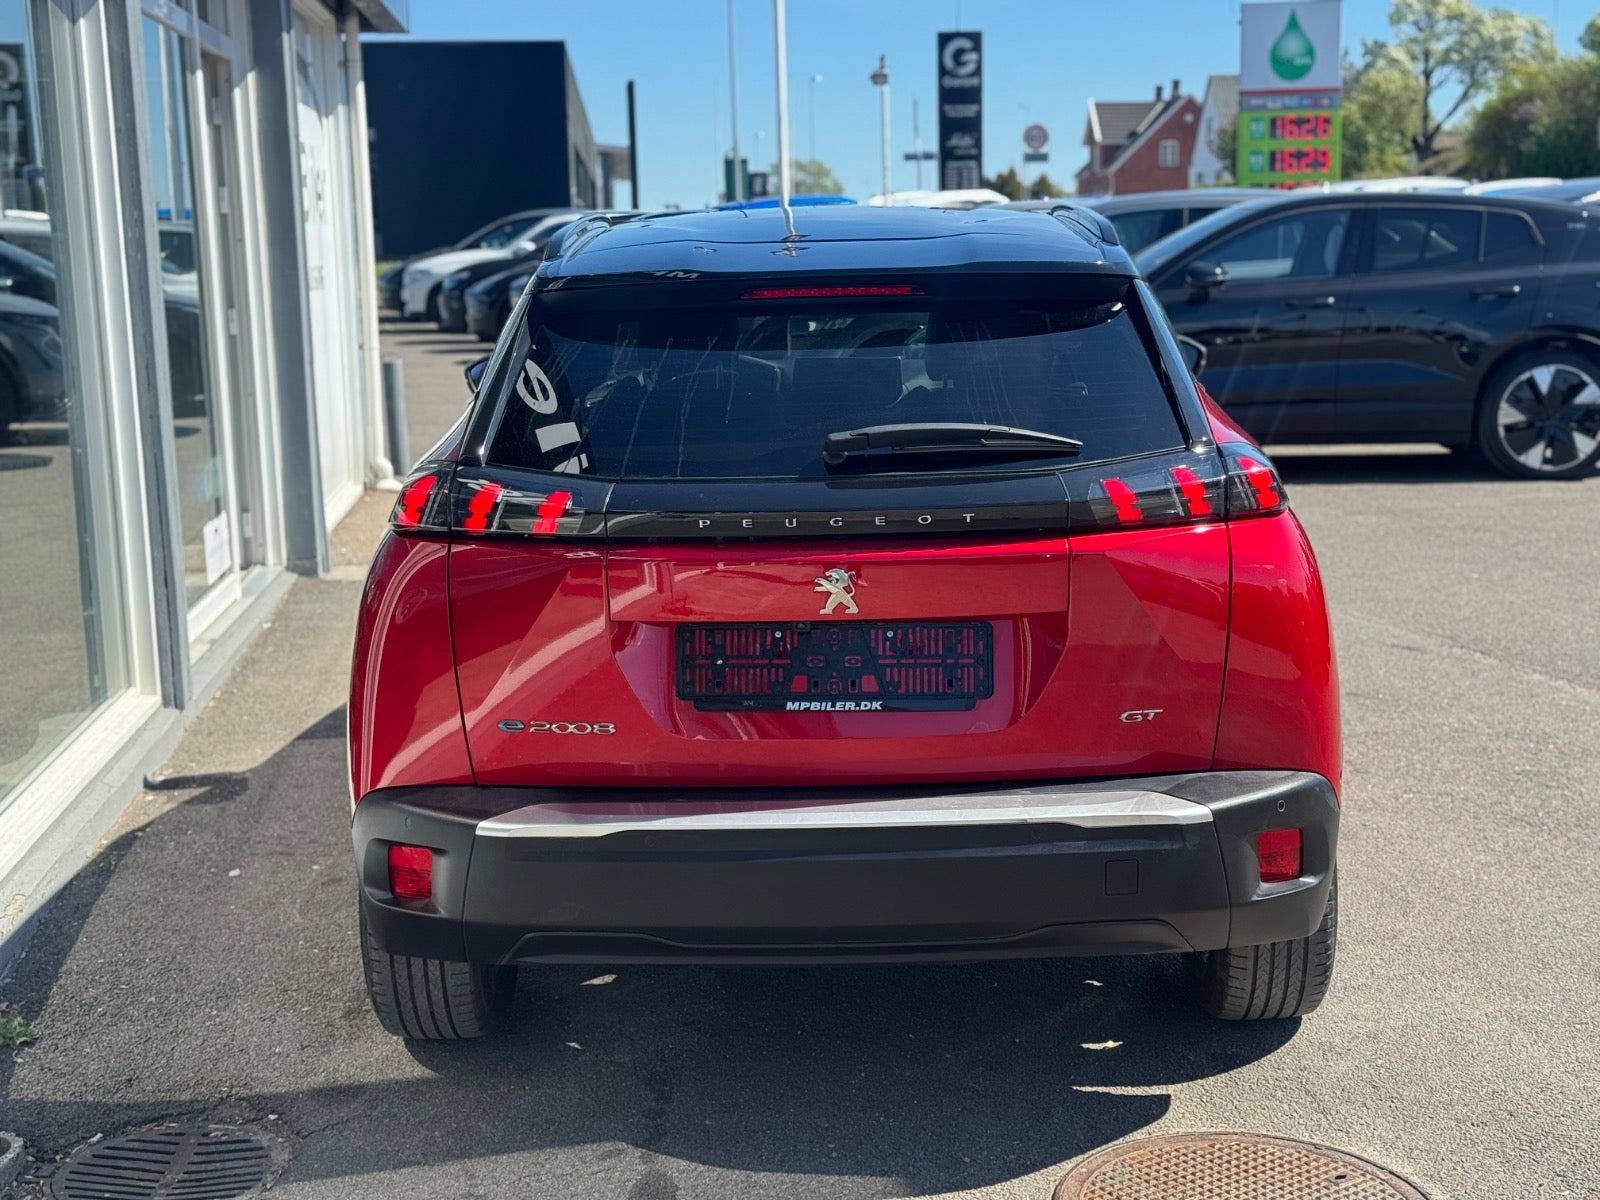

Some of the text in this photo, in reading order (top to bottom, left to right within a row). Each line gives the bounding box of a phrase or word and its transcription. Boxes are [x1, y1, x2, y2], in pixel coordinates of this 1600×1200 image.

[942, 37, 980, 76] G
[698, 512, 976, 529] PEUGEOT
[786, 700, 883, 711] MPBILER.DK
[1119, 708, 1164, 723] GT
